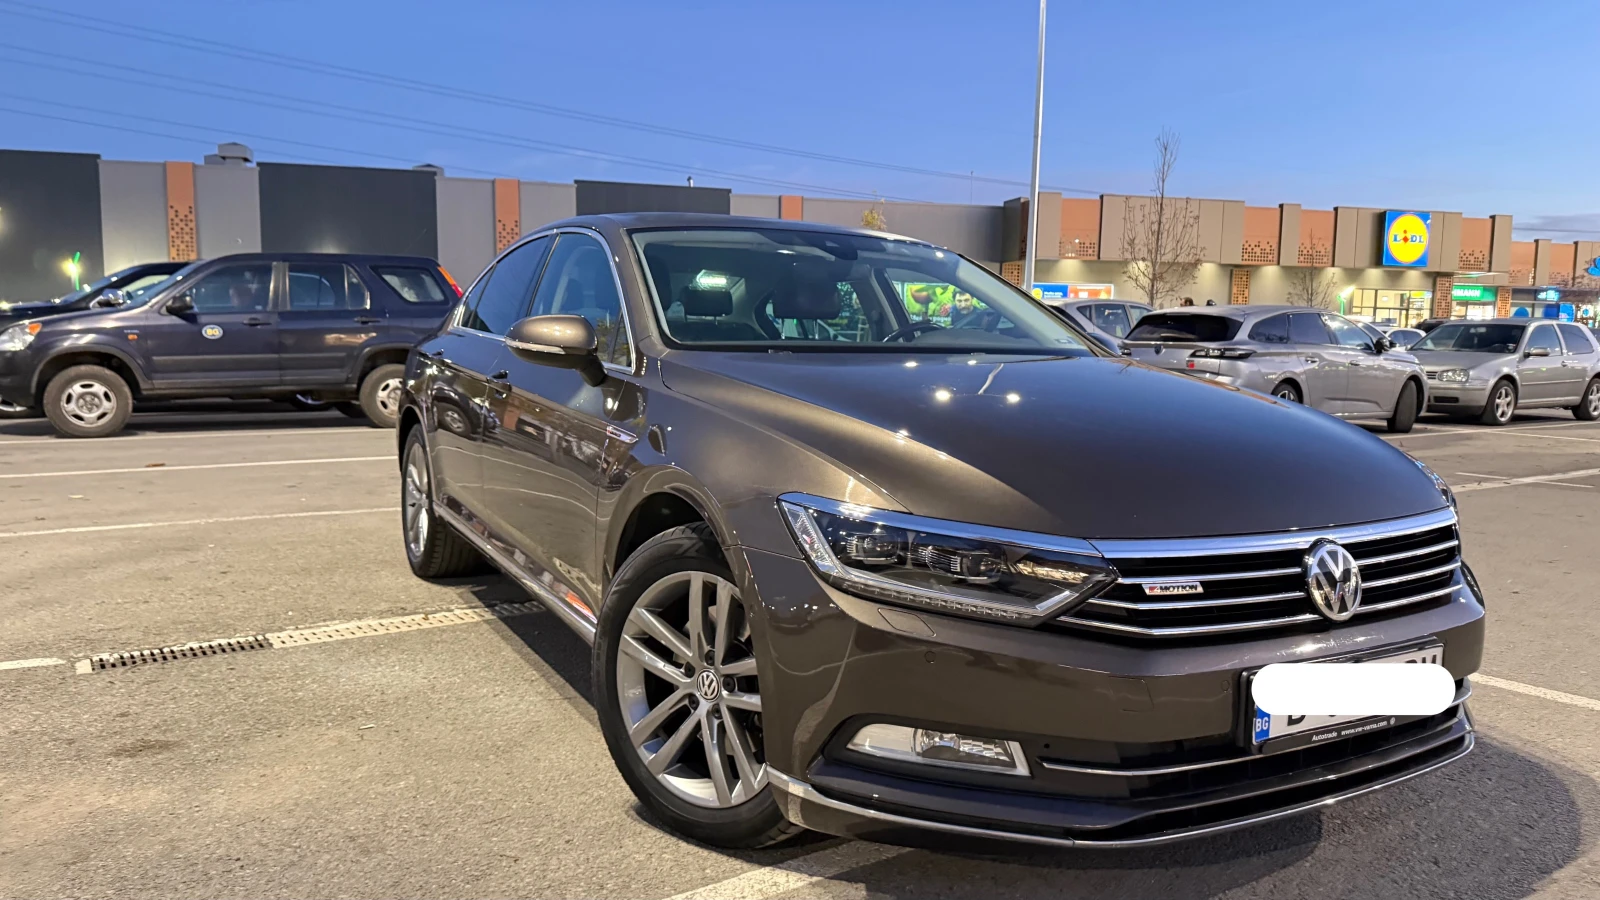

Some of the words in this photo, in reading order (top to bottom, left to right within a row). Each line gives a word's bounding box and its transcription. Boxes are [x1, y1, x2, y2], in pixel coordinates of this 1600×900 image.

[206, 328, 219, 336] BG
[1255, 716, 1269, 732] BG
[1311, 731, 1338, 742] Autotrade
